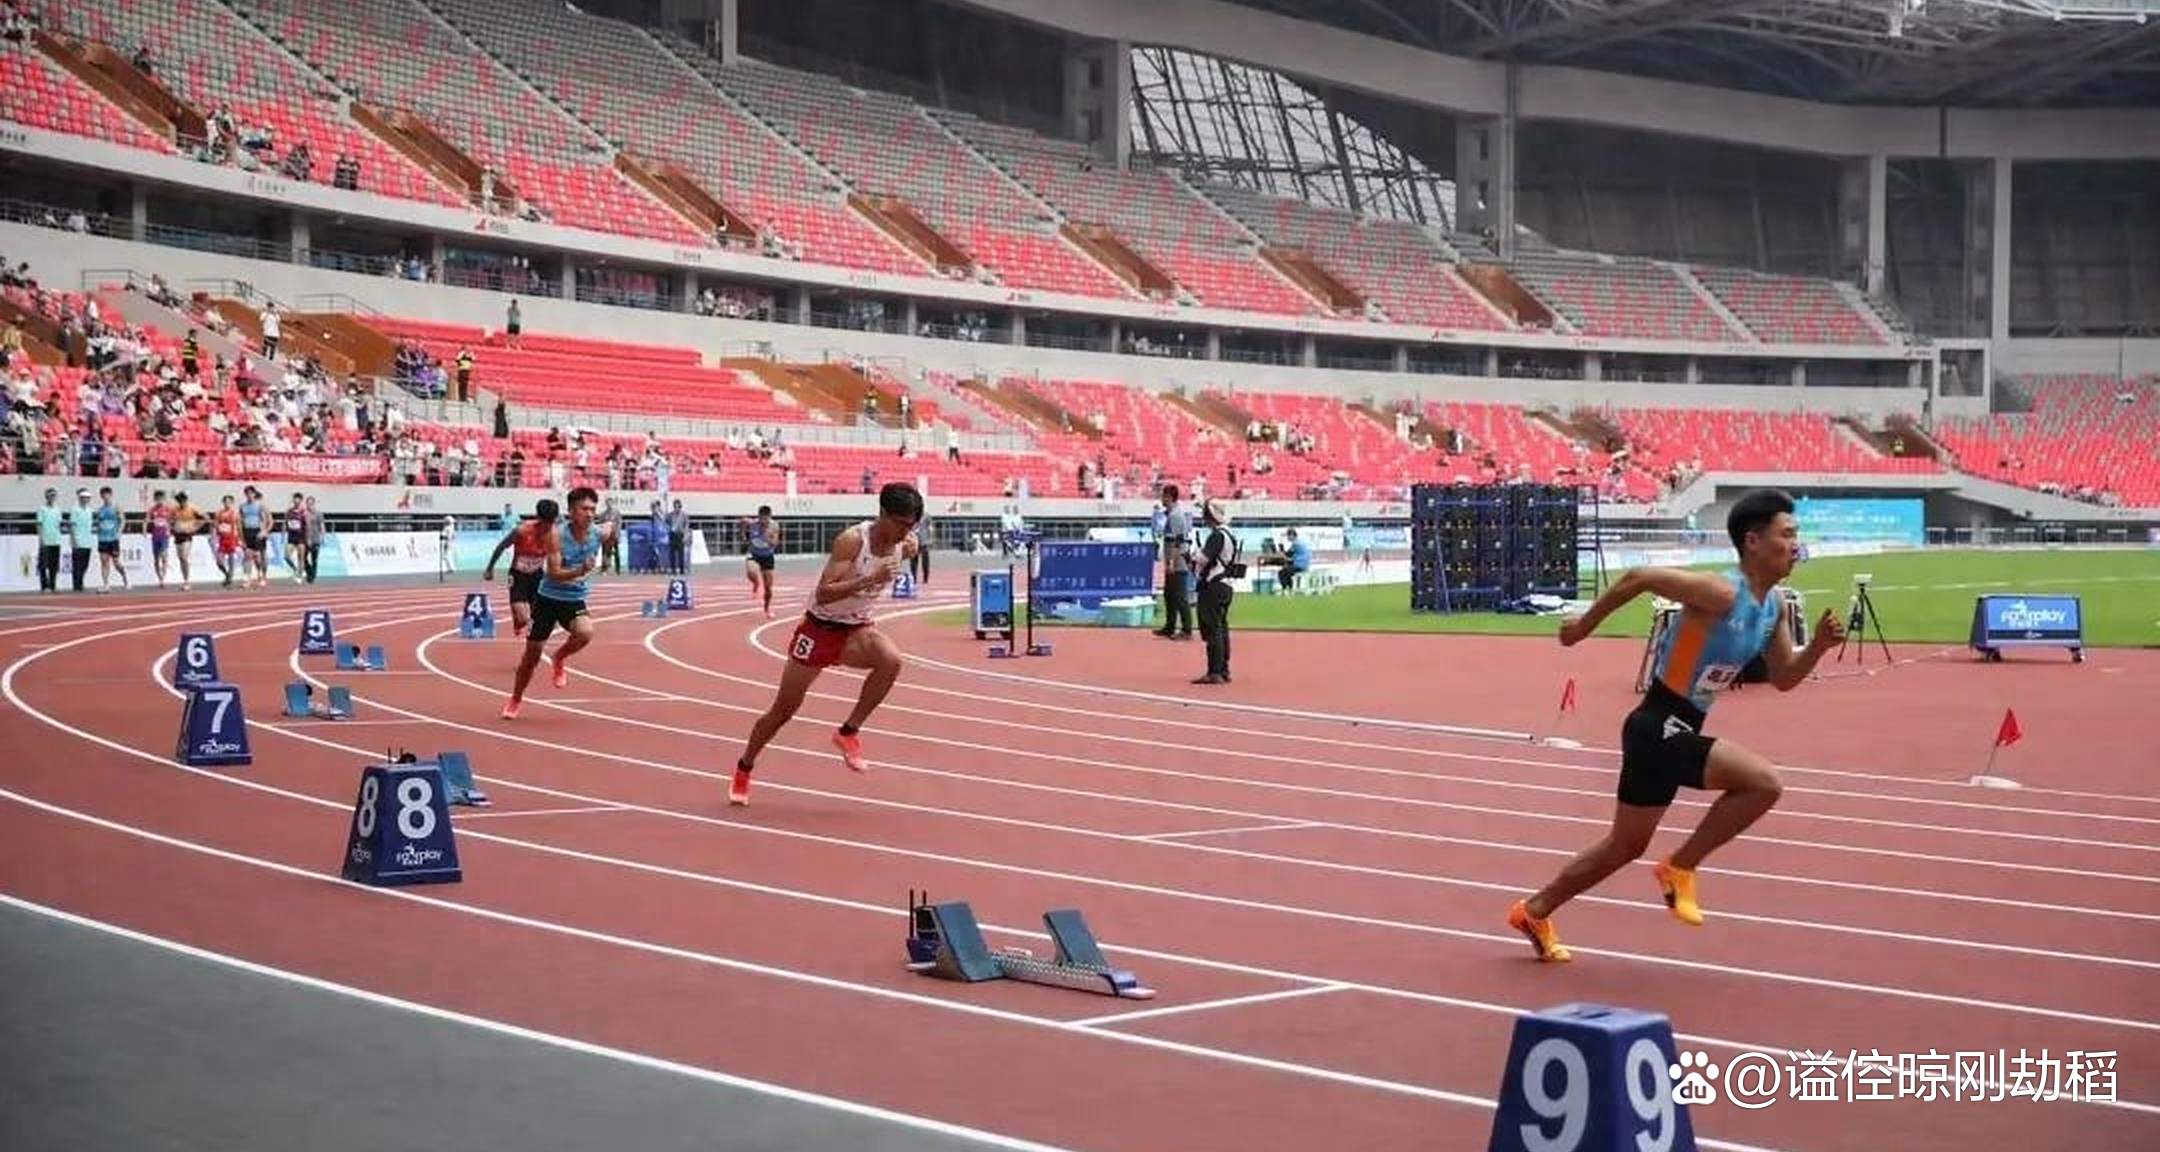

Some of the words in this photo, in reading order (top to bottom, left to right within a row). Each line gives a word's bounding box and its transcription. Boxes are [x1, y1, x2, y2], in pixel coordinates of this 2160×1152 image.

[672, 581, 683, 599] 3
[896, 574, 907, 589] 2
[468, 596, 483, 615] 4
[307, 613, 325, 637] 5
[186, 637, 209, 667] 6
[204, 691, 233, 733] 7
[358, 776, 379, 838] 8
[397, 777, 436, 839] 8
[1520, 1038, 1590, 1152] 9
[1625, 1038, 1676, 1152] 9
